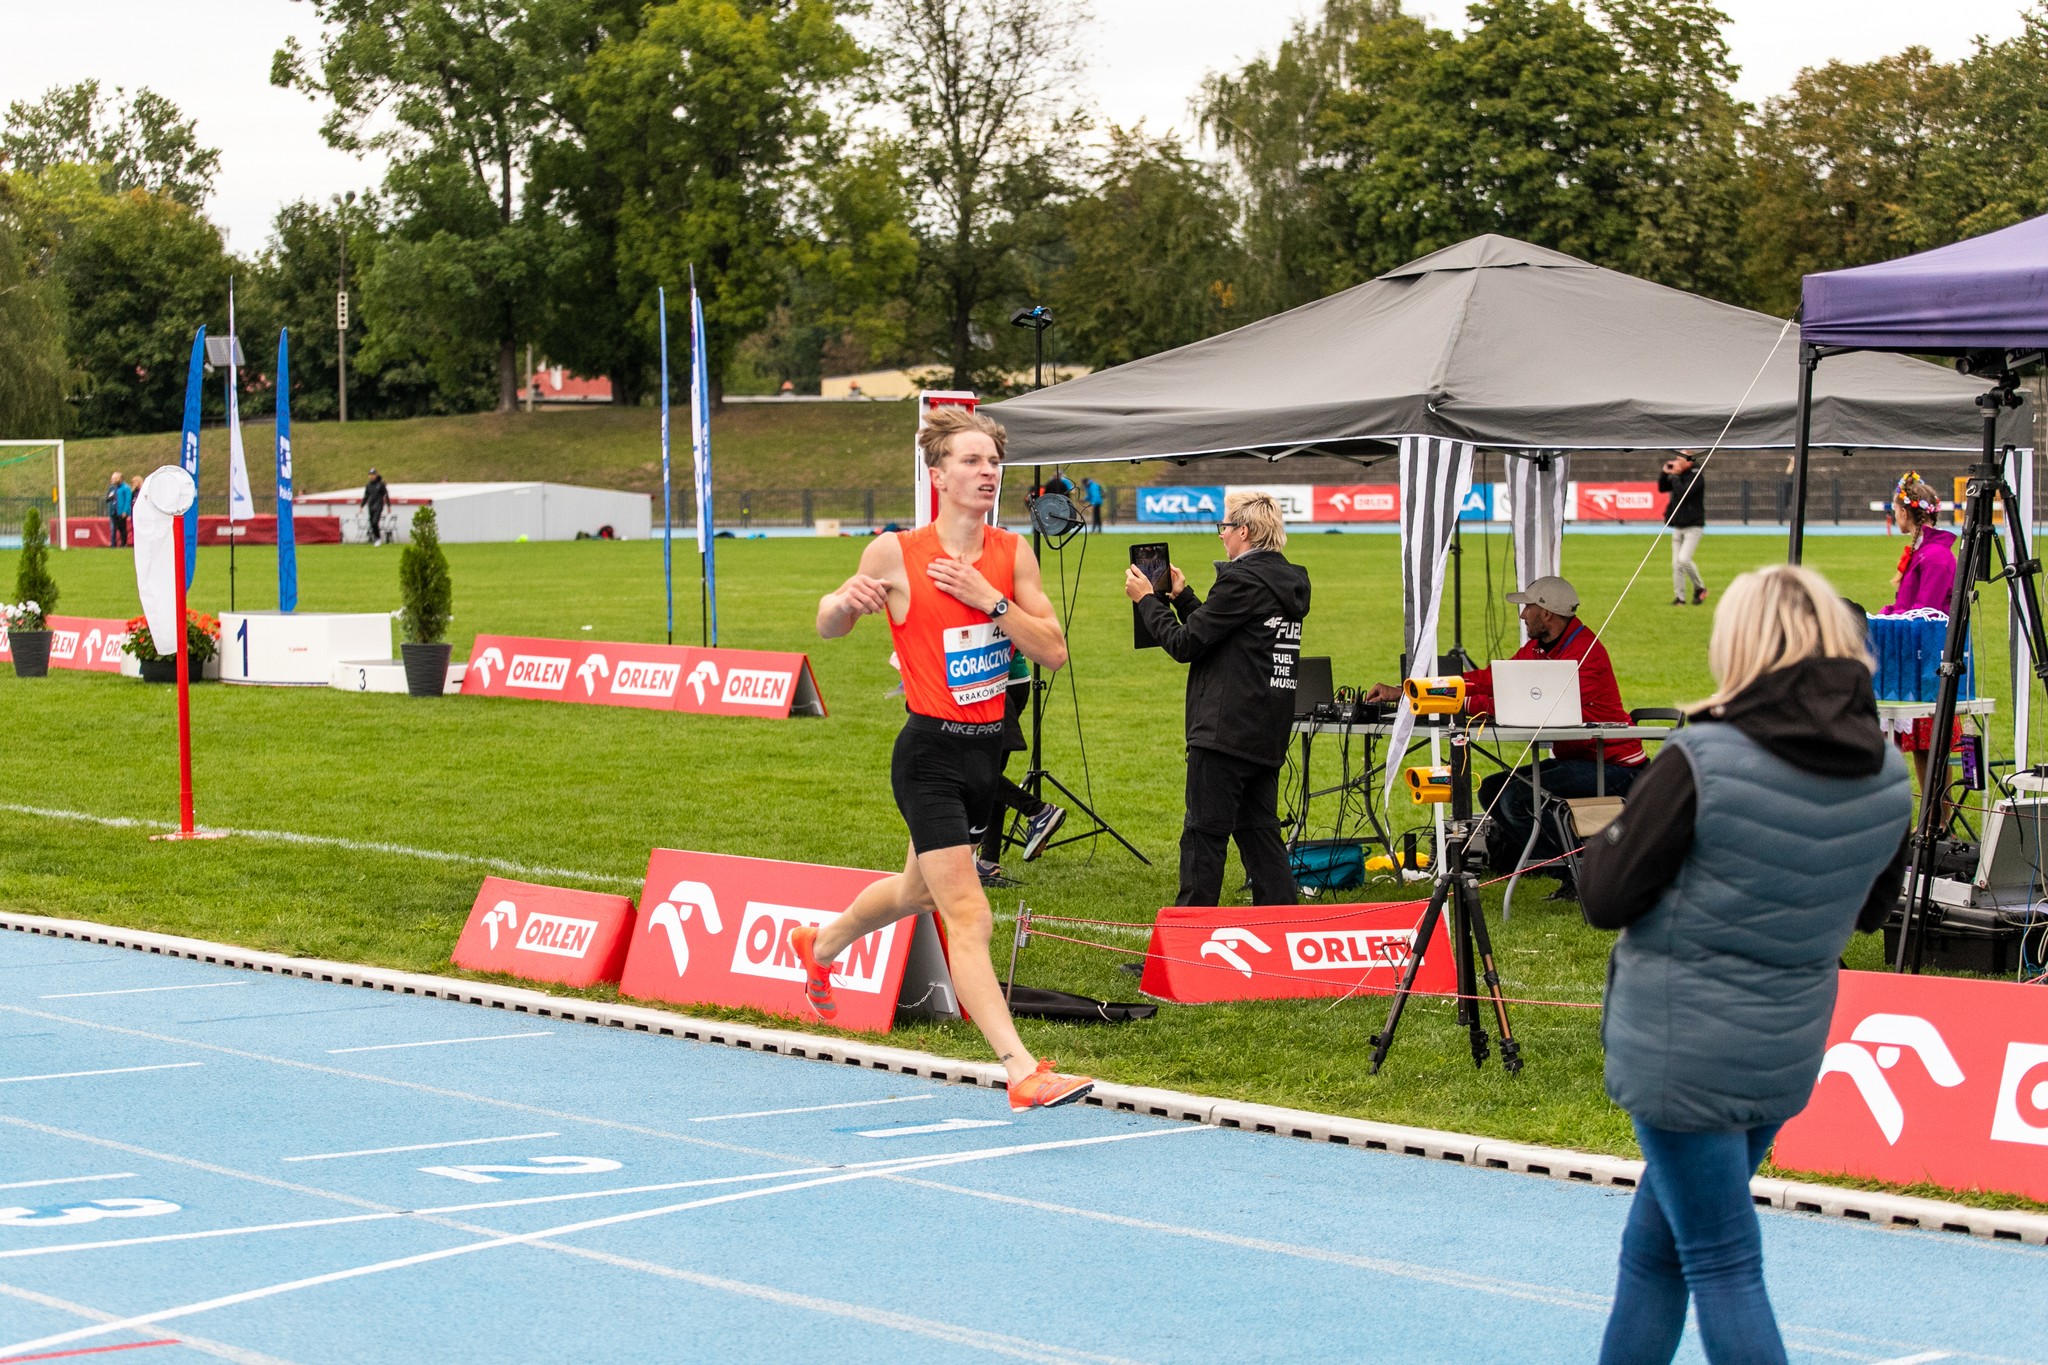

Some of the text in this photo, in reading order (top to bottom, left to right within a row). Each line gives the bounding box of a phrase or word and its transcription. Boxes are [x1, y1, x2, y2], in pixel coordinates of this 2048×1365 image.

[1145, 494, 1216, 513] MZLA
[237, 618, 249, 678] 1
[1272, 652, 1295, 665] FUEL
[512, 661, 565, 684] ORLEN
[949, 647, 1011, 678] GÓRALCZYK
[1273, 665, 1291, 677] THE
[358, 668, 367, 691] 3
[617, 667, 673, 691] ORLEN
[728, 674, 786, 700] ORLEN
[958, 687, 994, 703] KRAKÓW
[941, 721, 1002, 736] NIKE PRO
[524, 918, 590, 952] ORLEN
[745, 914, 883, 980] ORN
[416, 1156, 623, 1184] 2
[0, 1198, 182, 1227] 3
